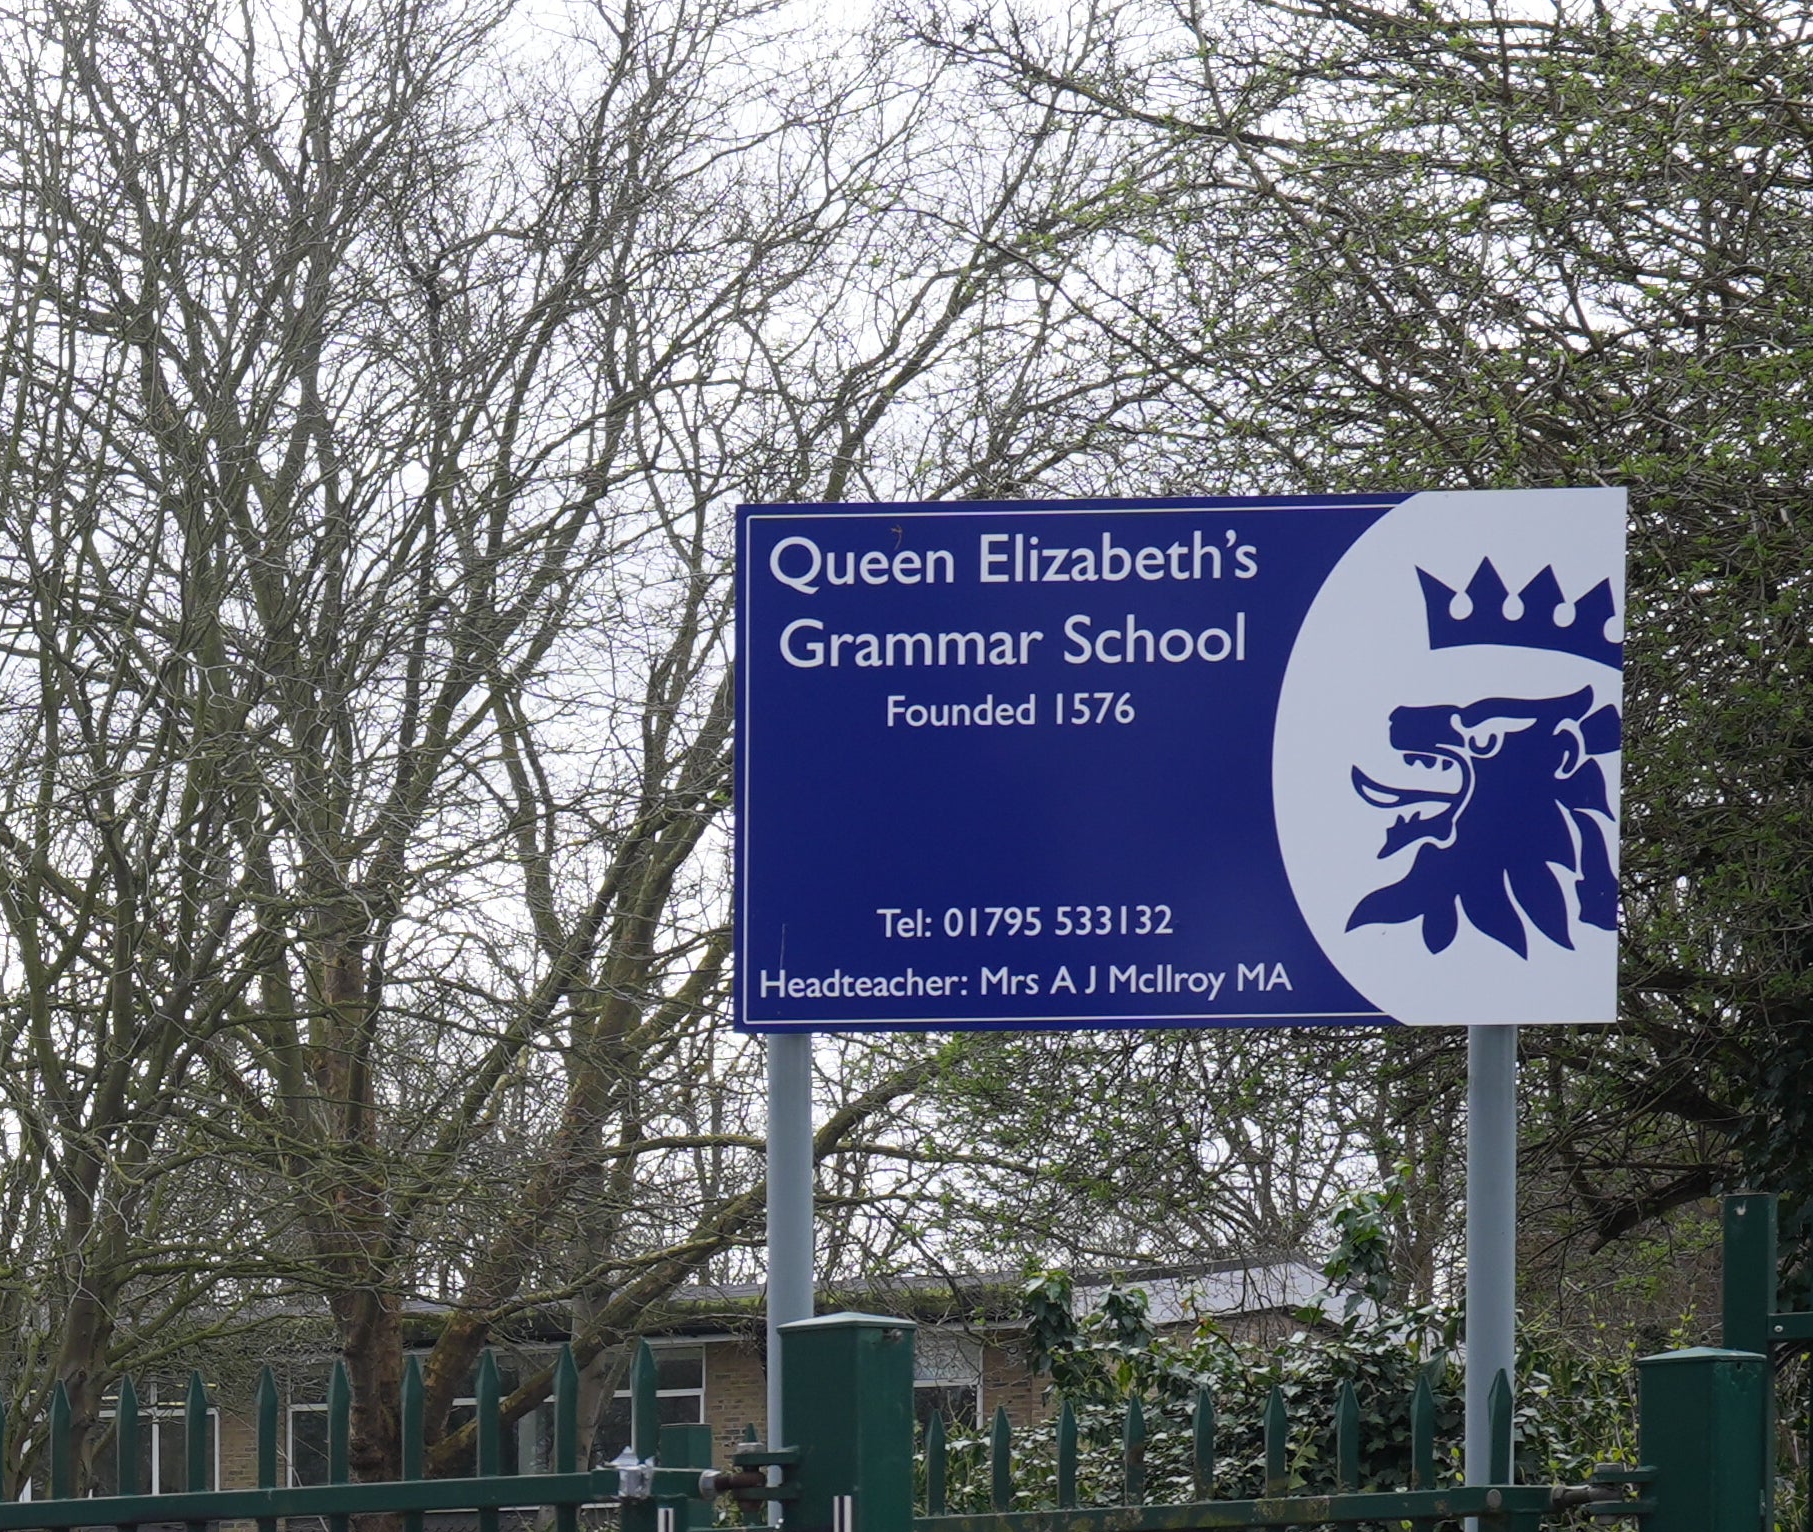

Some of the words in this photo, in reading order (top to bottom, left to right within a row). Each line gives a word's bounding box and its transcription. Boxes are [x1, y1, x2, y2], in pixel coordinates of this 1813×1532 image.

[769, 536, 954, 595] Queen
[980, 529, 1258, 583] Elizabeth's
[779, 618, 1044, 668] Grammar
[1063, 611, 1245, 664] School
[887, 693, 1036, 727] Founded
[1056, 692, 1135, 725] 1576
[876, 908, 932, 938] Tel:
[943, 906, 1042, 937] 01795
[1054, 904, 1173, 936] 533132
[760, 967, 968, 998] Headteacher:
[980, 966, 1039, 996] Mrs
[1049, 965, 1077, 995] A
[1084, 965, 1096, 994] J
[1109, 964, 1226, 1001] McIlroy
[1237, 962, 1293, 992] MA
